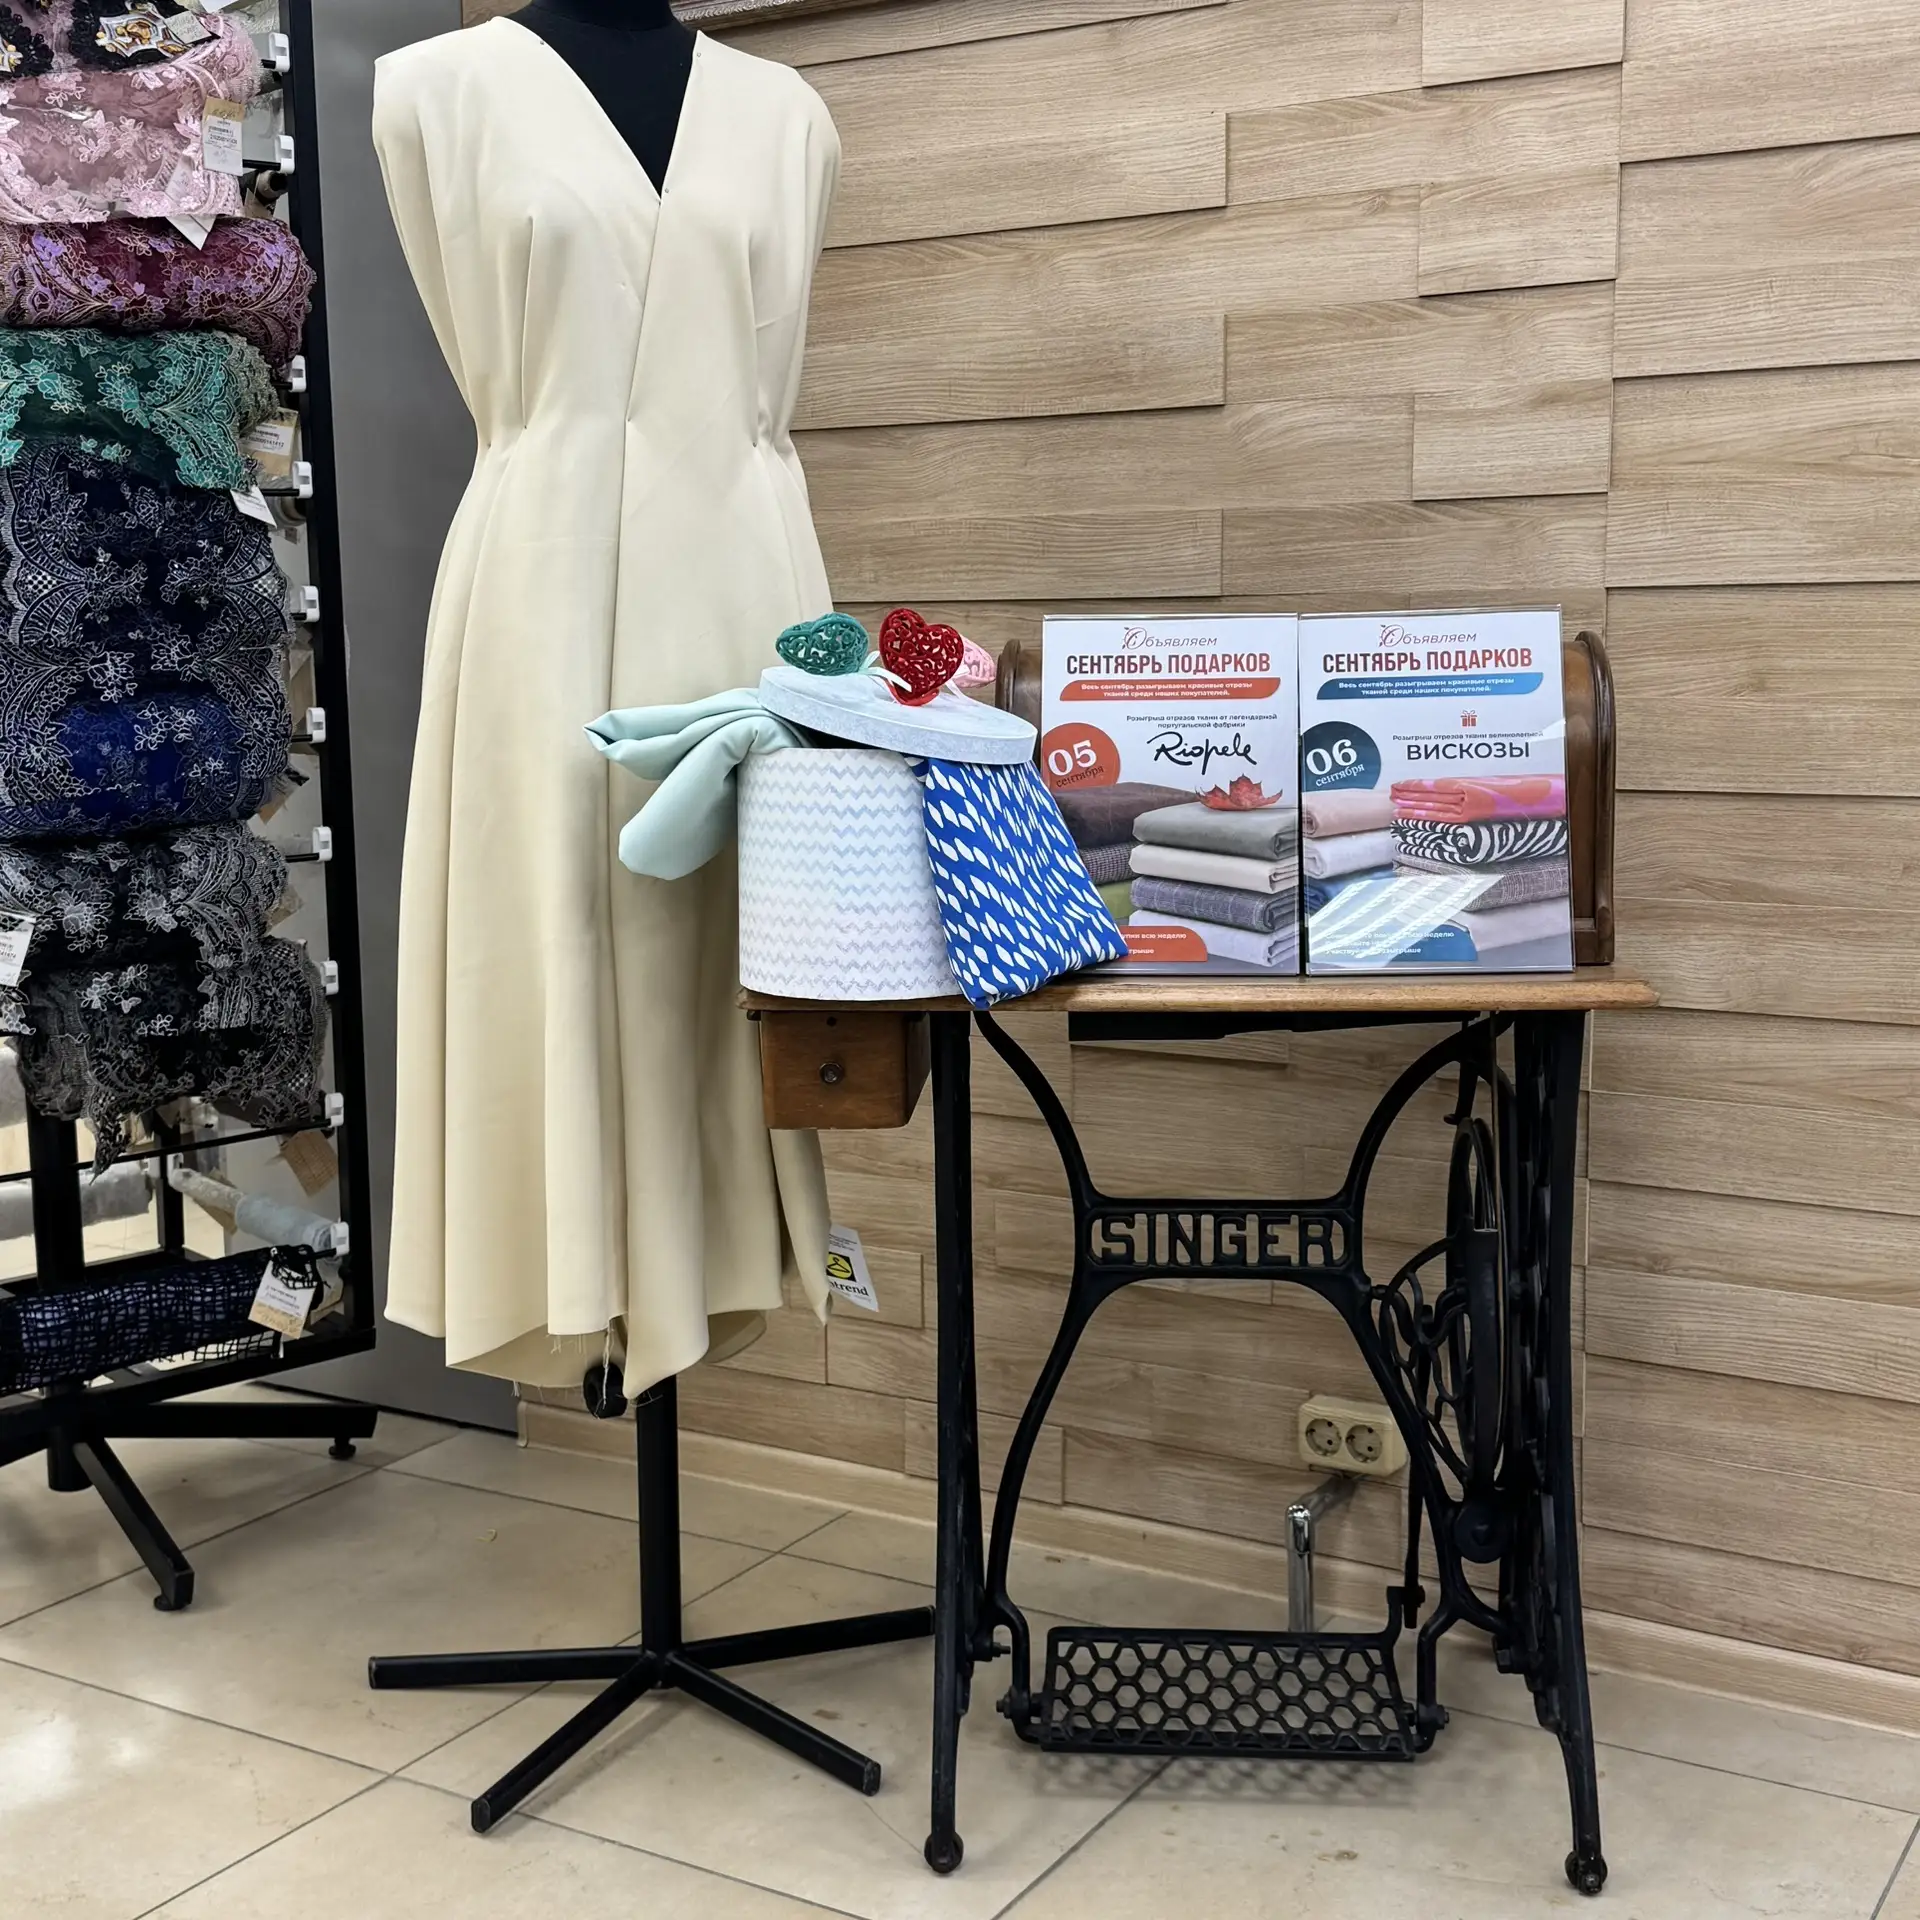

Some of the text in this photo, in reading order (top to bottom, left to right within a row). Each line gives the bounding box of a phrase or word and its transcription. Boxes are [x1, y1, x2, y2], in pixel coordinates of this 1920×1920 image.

[1123, 627, 1217, 650] Объявляем
[1380, 624, 1477, 647] Объявляем
[1067, 653, 1270, 675] СЕНТЯБРЬ ПОДАРКОВ
[1323, 648, 1532, 673] СЕНТЯБРЬ ПОДАРКОВ
[1131, 690, 1154, 698] среди
[1181, 688, 1230, 698] покупателей.
[1136, 682, 1186, 690] разыгрываем
[1188, 682, 1224, 690] красивые
[1358, 681, 1393, 689] сентябрь
[1395, 680, 1447, 688] разыгрываем
[1448, 678, 1485, 686] красивые
[1486, 677, 1515, 685] отрезы
[1361, 688, 1388, 696] тканей
[1389, 688, 1413, 696] среди
[1441, 685, 1492, 694] покупателей.
[1157, 721, 1246, 729] португальской фабрики
[1229, 713, 1278, 721] легендарной
[1392, 733, 1432, 741] Розыгрыш
[1433, 732, 1464, 740] отрезов
[1048, 739, 1097, 776] 05
[1146, 731, 1257, 776] Riopele
[1306, 739, 1358, 775] 06
[1407, 742, 1530, 760] ВИСКОЗЫ
[1056, 765, 1104, 788] сентября
[1315, 763, 1365, 787] сентября
[1101, 1215, 1334, 1266] SINGER
